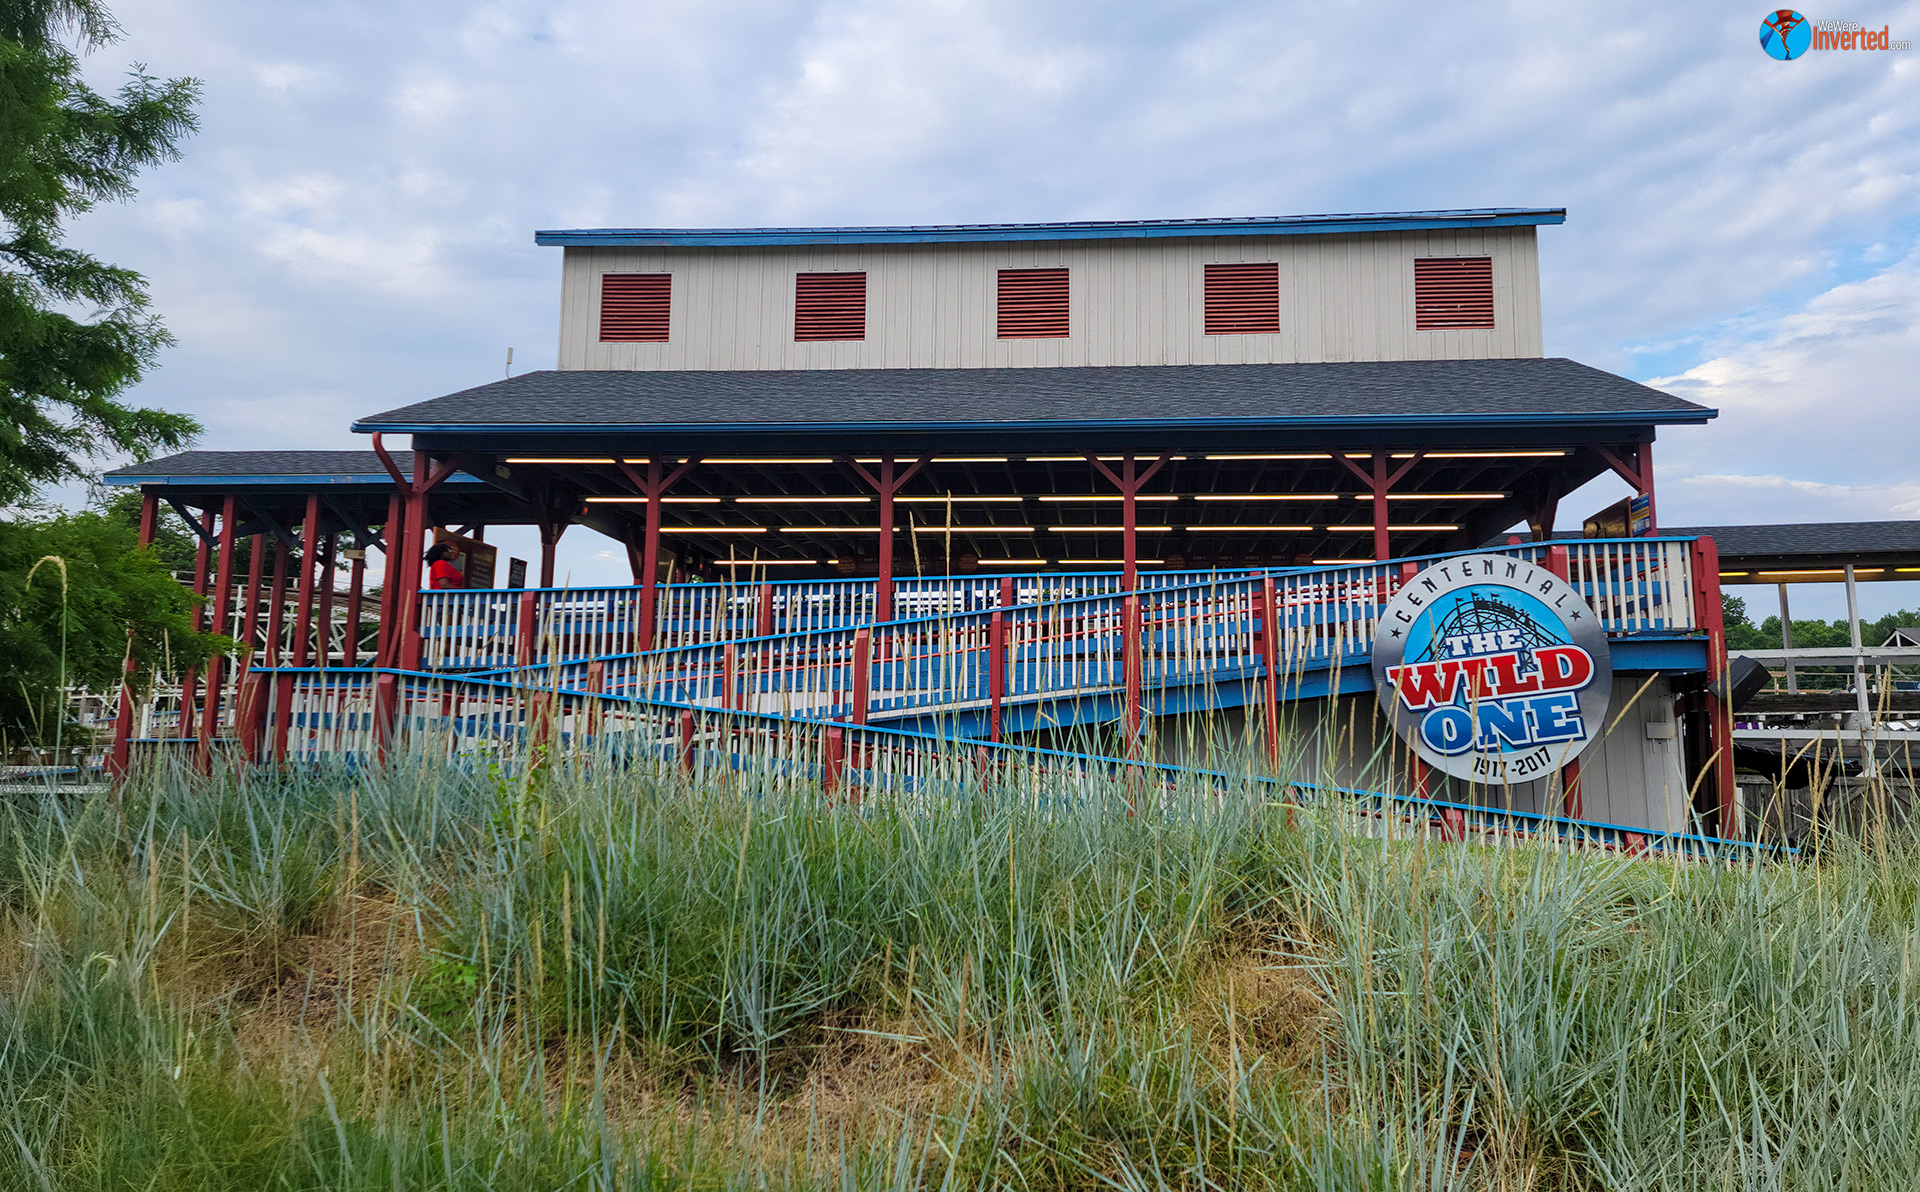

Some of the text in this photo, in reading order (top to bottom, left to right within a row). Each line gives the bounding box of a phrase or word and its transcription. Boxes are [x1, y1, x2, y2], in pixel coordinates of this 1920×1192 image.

[1395, 559, 1569, 624] CENTENNIAL
[1445, 628, 1524, 657] THE
[1385, 644, 1595, 711] WILD
[1420, 690, 1586, 755] ONE
